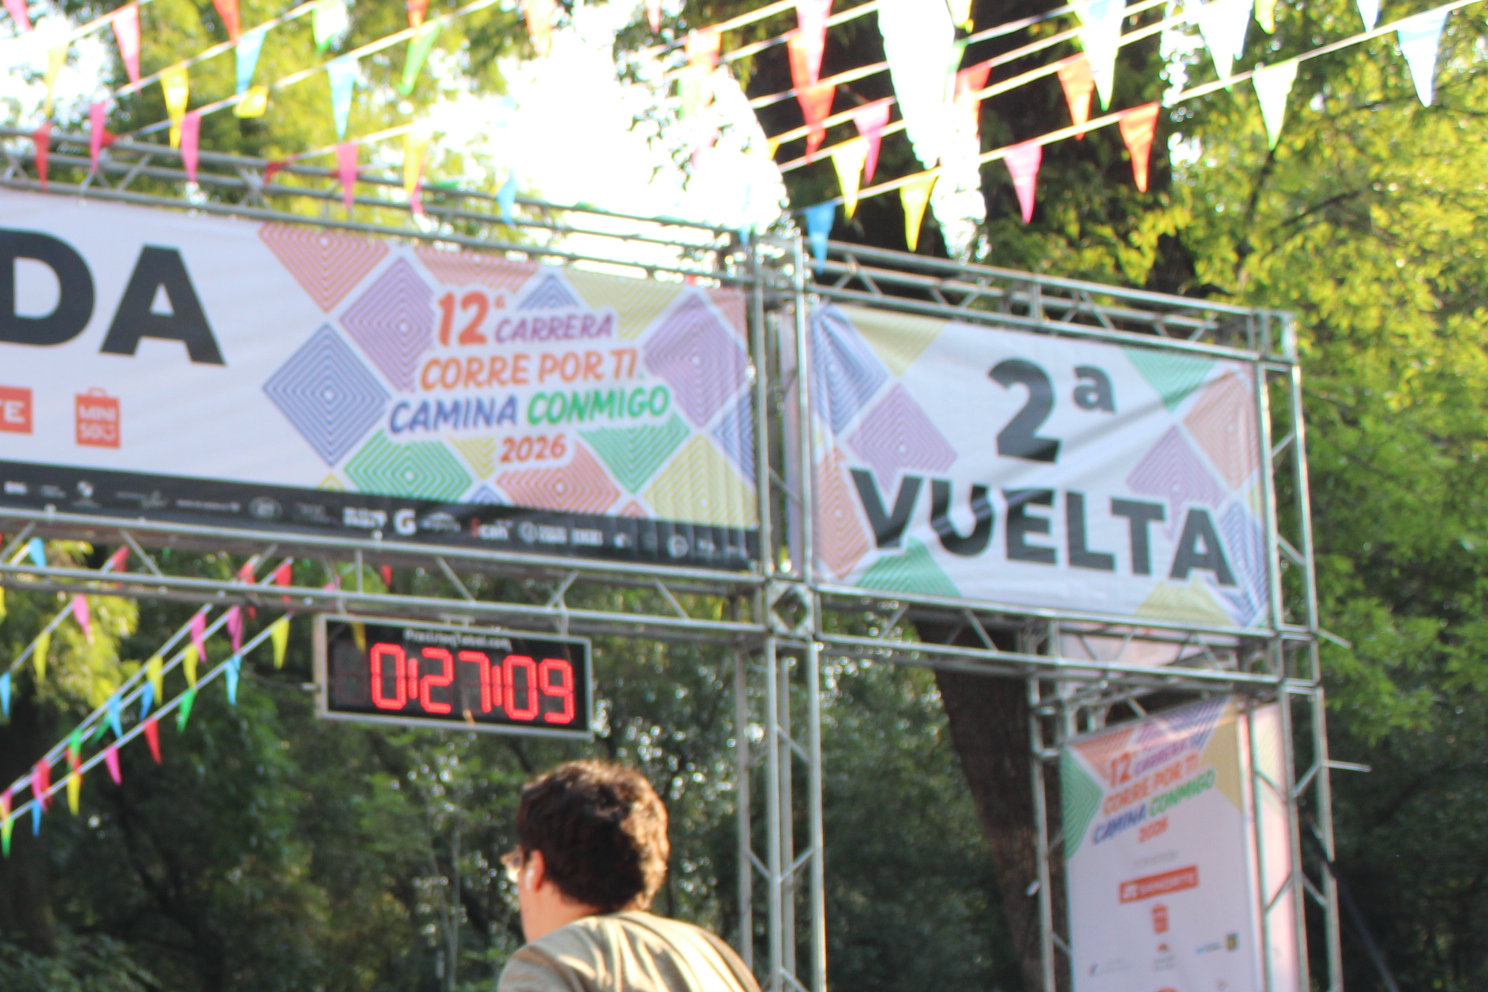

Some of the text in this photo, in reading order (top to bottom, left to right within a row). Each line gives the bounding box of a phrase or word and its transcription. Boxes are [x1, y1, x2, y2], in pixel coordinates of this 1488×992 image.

[495, 314, 614, 345] CARRERA
[420, 348, 638, 392] CORRE POR TI
[389, 384, 670, 435] CAMINA CONMIGO
[500, 434, 566, 464] 2026
[849, 466, 1239, 588] VUELTA
